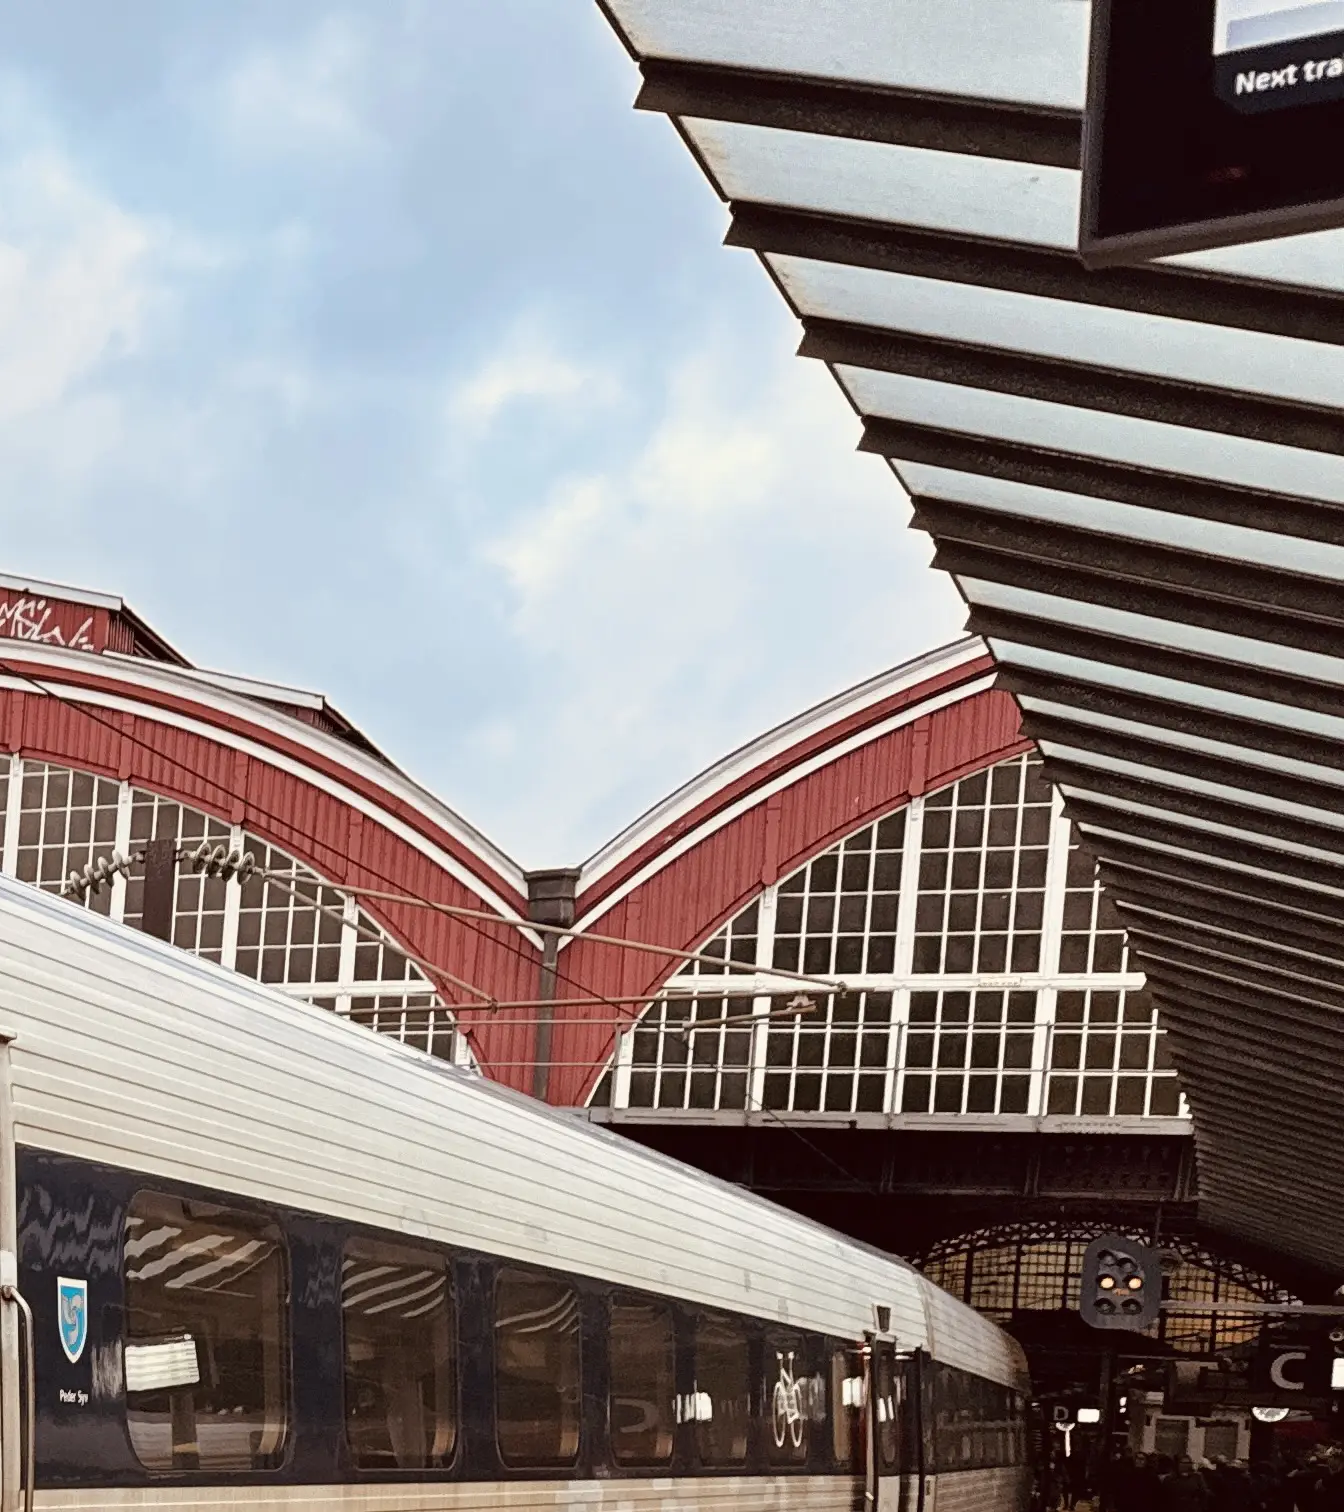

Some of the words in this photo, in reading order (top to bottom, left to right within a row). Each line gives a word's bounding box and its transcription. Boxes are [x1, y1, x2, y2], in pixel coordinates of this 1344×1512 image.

[1235, 63, 1298, 96] Next
[1303, 54, 1344, 82] tra
[1270, 1352, 1307, 1390] C
